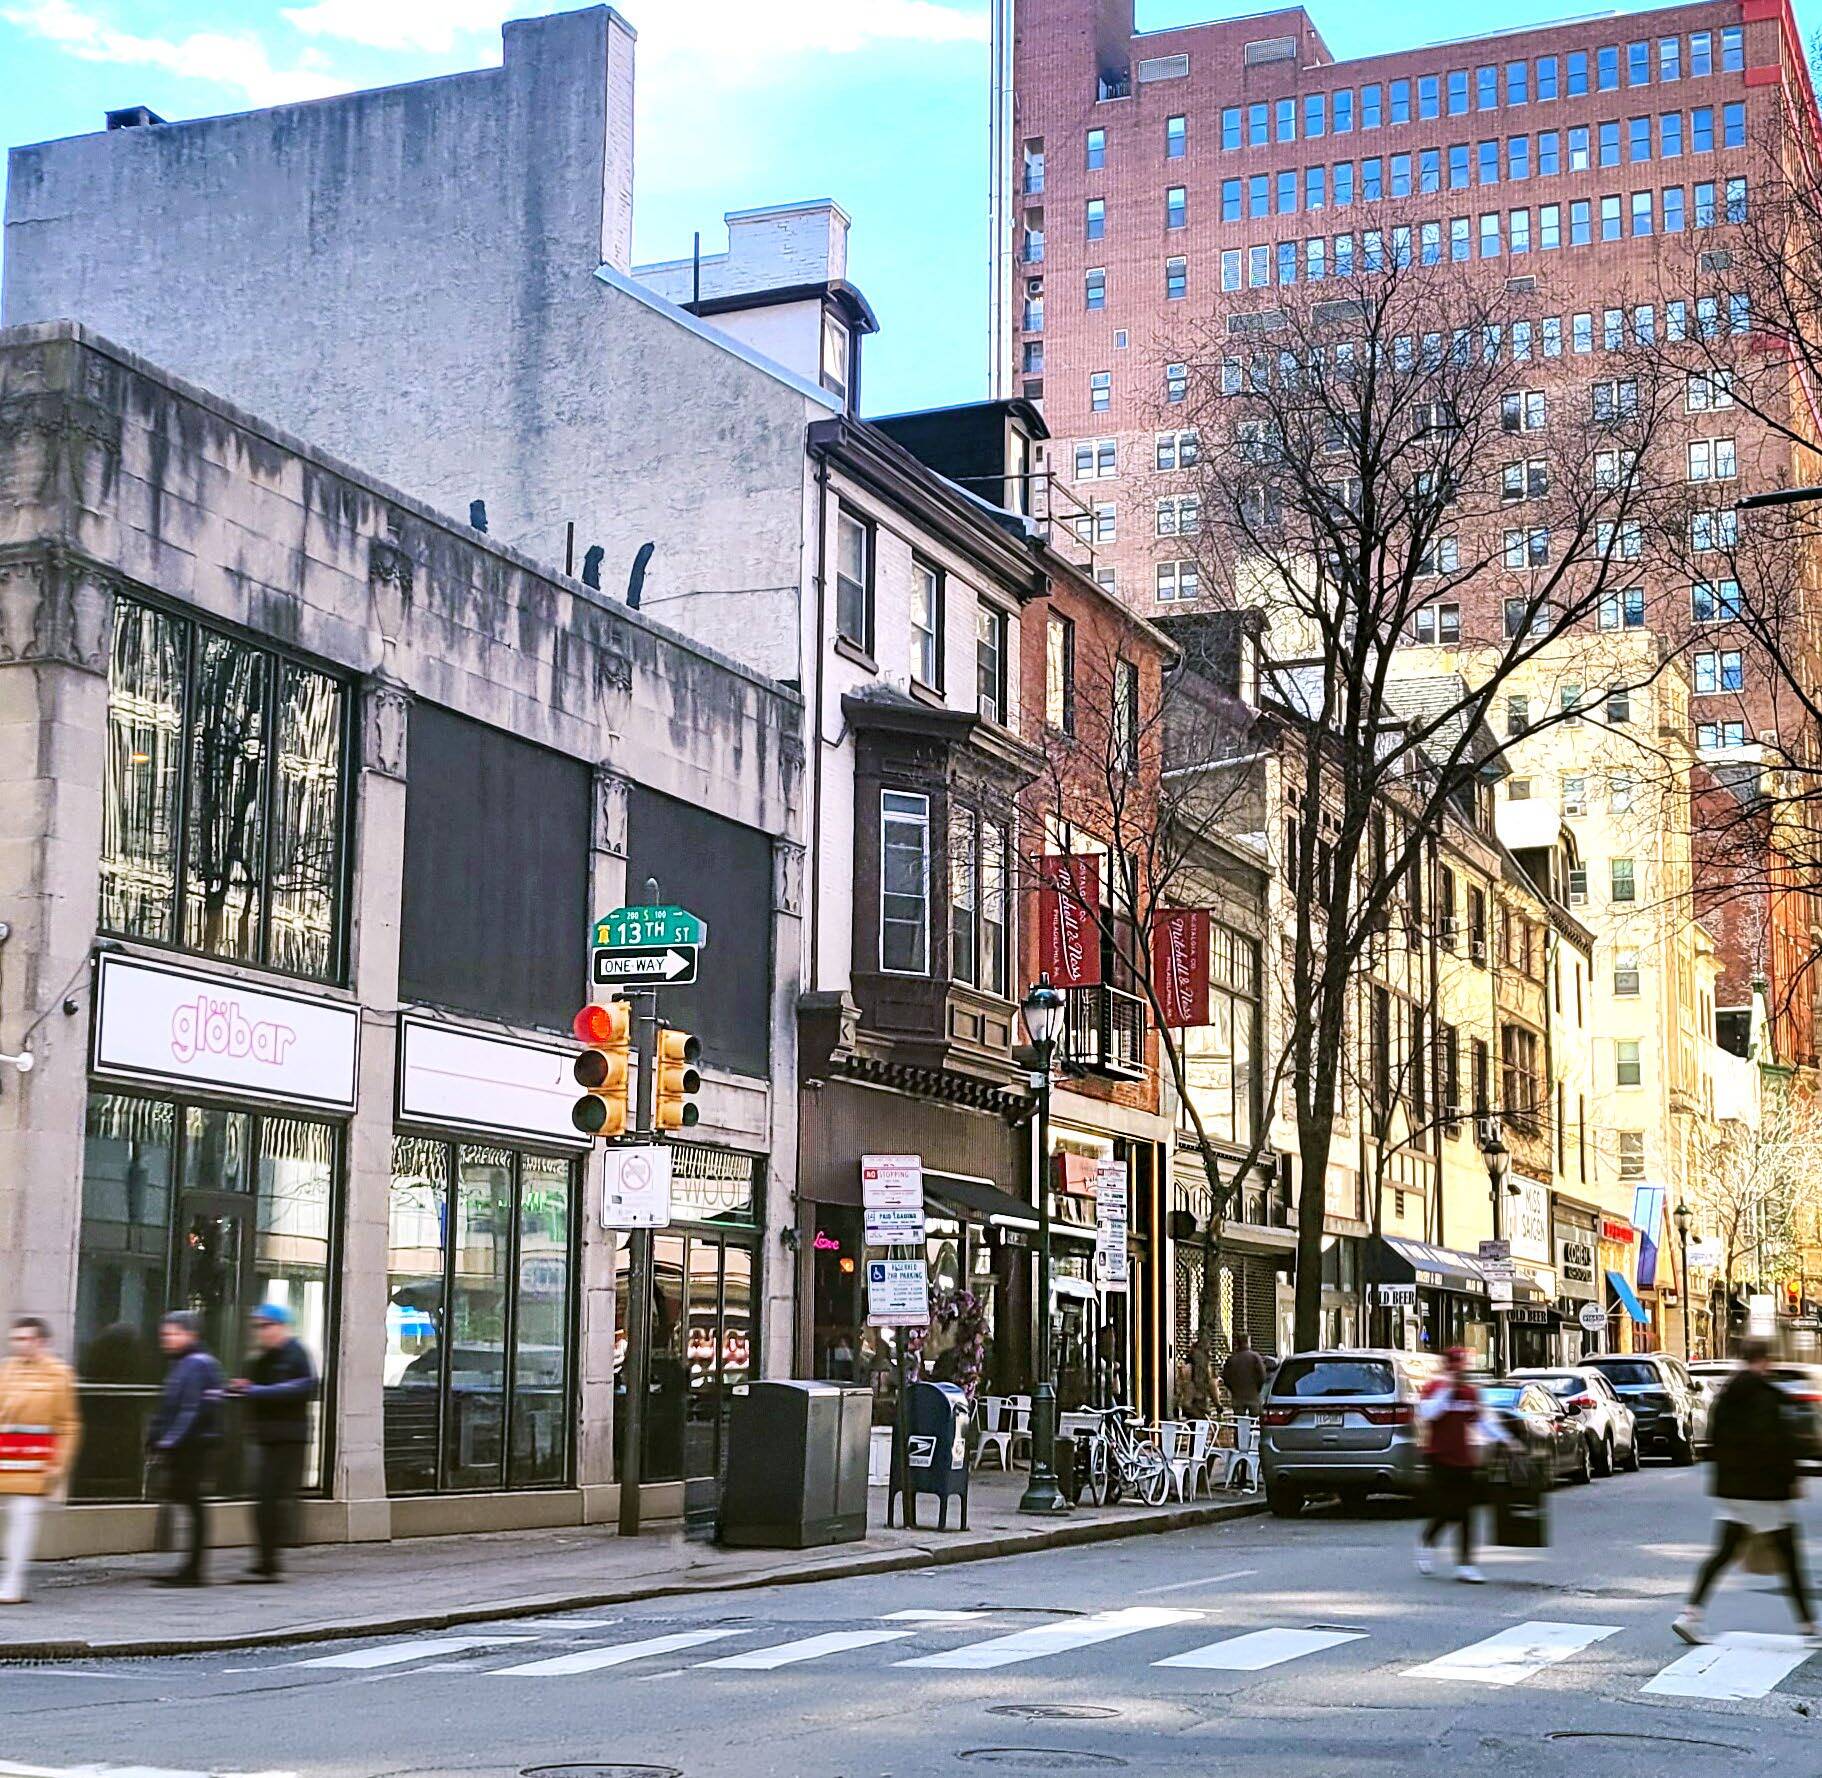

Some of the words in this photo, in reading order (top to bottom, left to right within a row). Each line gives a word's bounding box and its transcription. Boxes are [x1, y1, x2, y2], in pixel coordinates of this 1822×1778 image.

[1057, 868, 1078, 929] Mchell
[626, 911, 639, 920] 200
[643, 909, 649, 920] S
[654, 910, 667, 919] 100
[617, 921, 664, 945] 13TH
[674, 926, 690, 942] ST
[1067, 931, 1078, 943] &
[1171, 918, 1191, 975] Mitchell
[605, 960, 631, 973] ONE
[636, 959, 664, 971] WAY
[1068, 943, 1084, 981] Ness
[1179, 976, 1191, 986] &
[1179, 986, 1194, 1022] Ness
[171, 995, 296, 1065] glöbar
[879, 1171, 909, 1179] STOPPING
[1525, 1187, 1541, 1214] MISS
[1521, 1213, 1545, 1243] SAIGON
[813, 1230, 840, 1250] Love
[899, 1271, 923, 1280] PARKING
[1367, 1291, 1389, 1305] CLD
[1392, 1291, 1415, 1304] BEER
[1506, 1308, 1525, 1322] COLD
[1527, 1309, 1547, 1323] BEER
